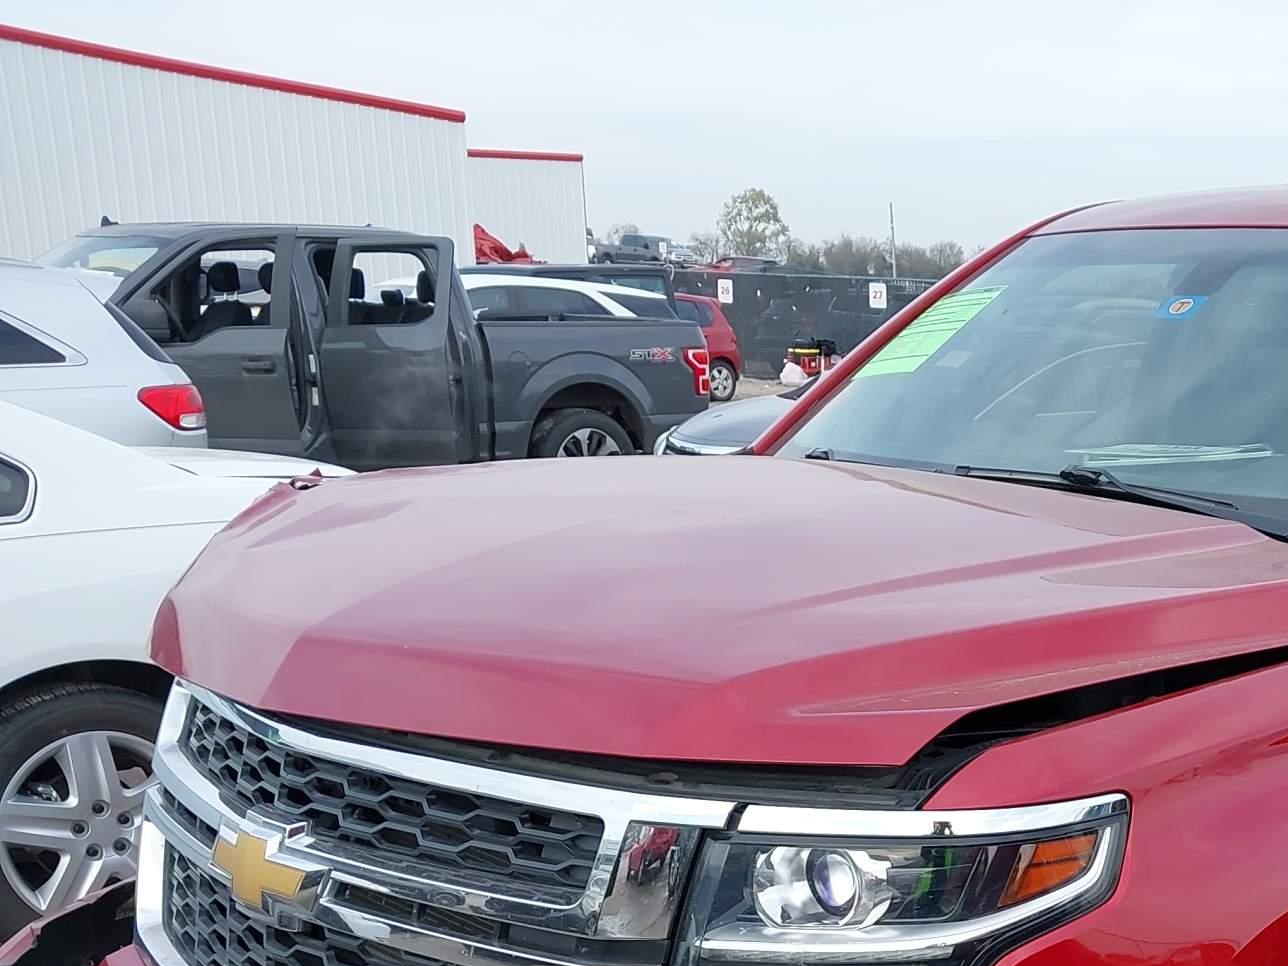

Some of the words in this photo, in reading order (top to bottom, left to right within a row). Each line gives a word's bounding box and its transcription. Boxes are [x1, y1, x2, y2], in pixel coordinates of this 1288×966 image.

[720, 285, 730, 296] 26
[872, 290, 883, 300] 27
[629, 346, 676, 362] STX
